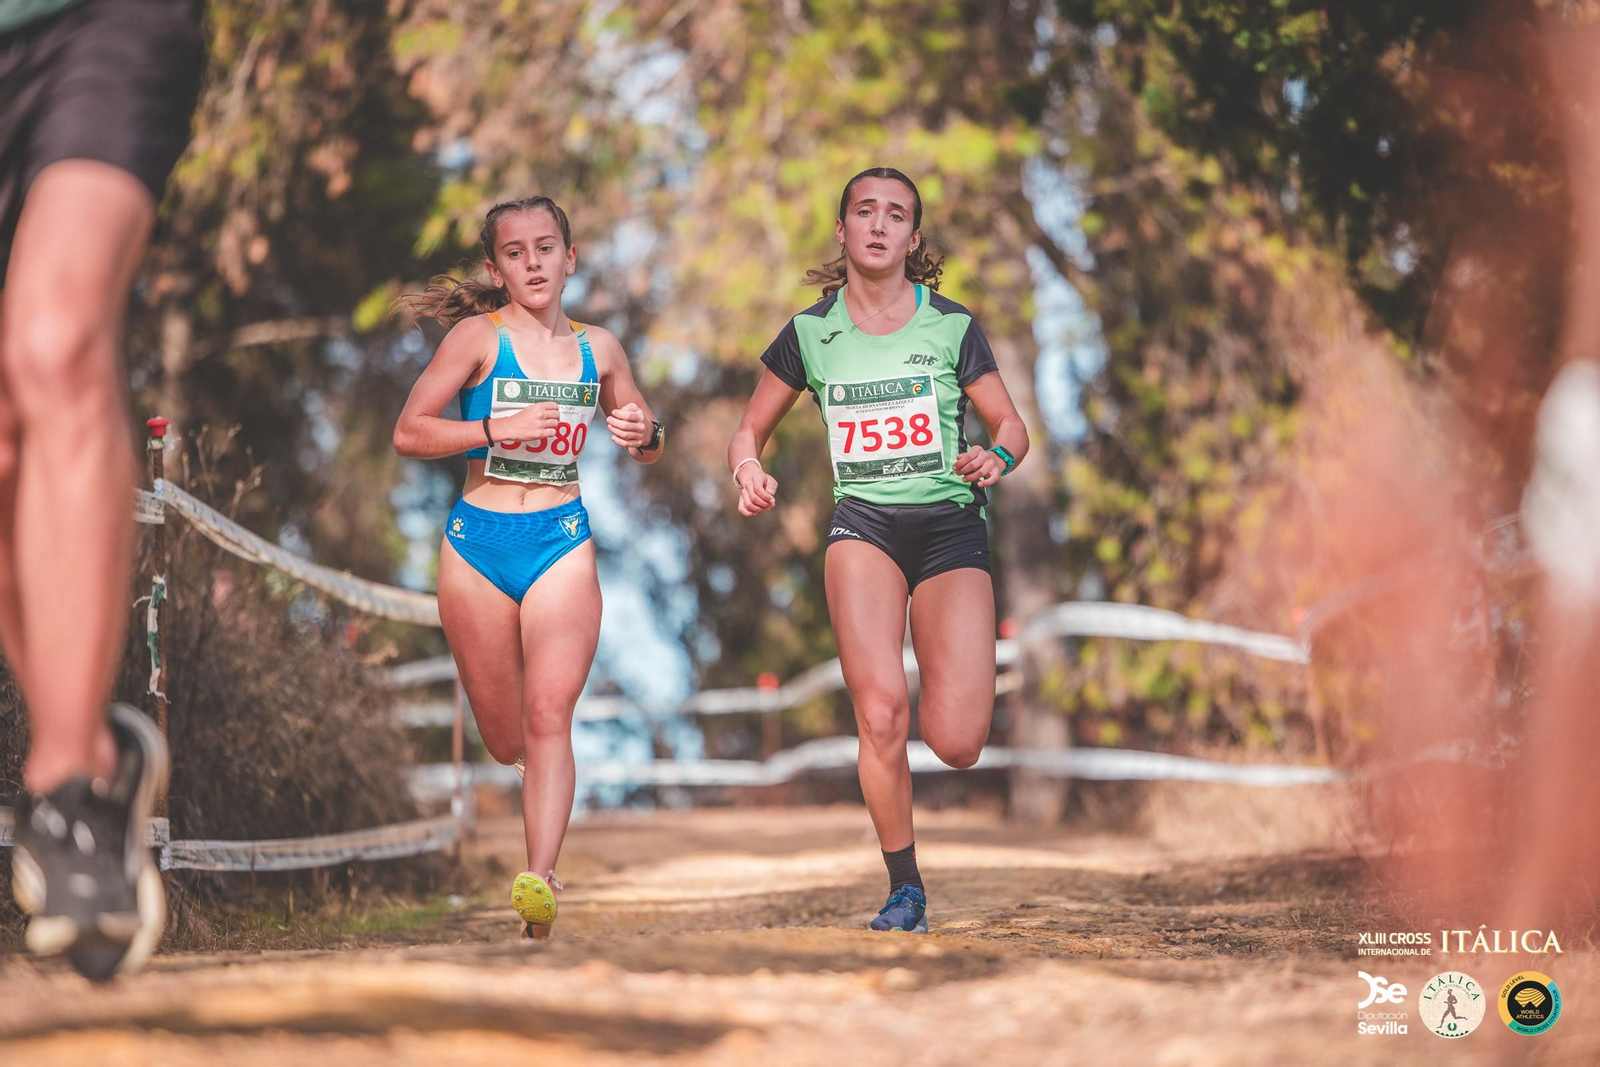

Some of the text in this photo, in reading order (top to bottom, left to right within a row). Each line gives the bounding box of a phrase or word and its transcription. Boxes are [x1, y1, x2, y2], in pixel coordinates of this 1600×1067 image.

[528, 383, 579, 399] ITÁLICA
[851, 382, 904, 398] ITÁLICA
[837, 413, 934, 454] 7538
